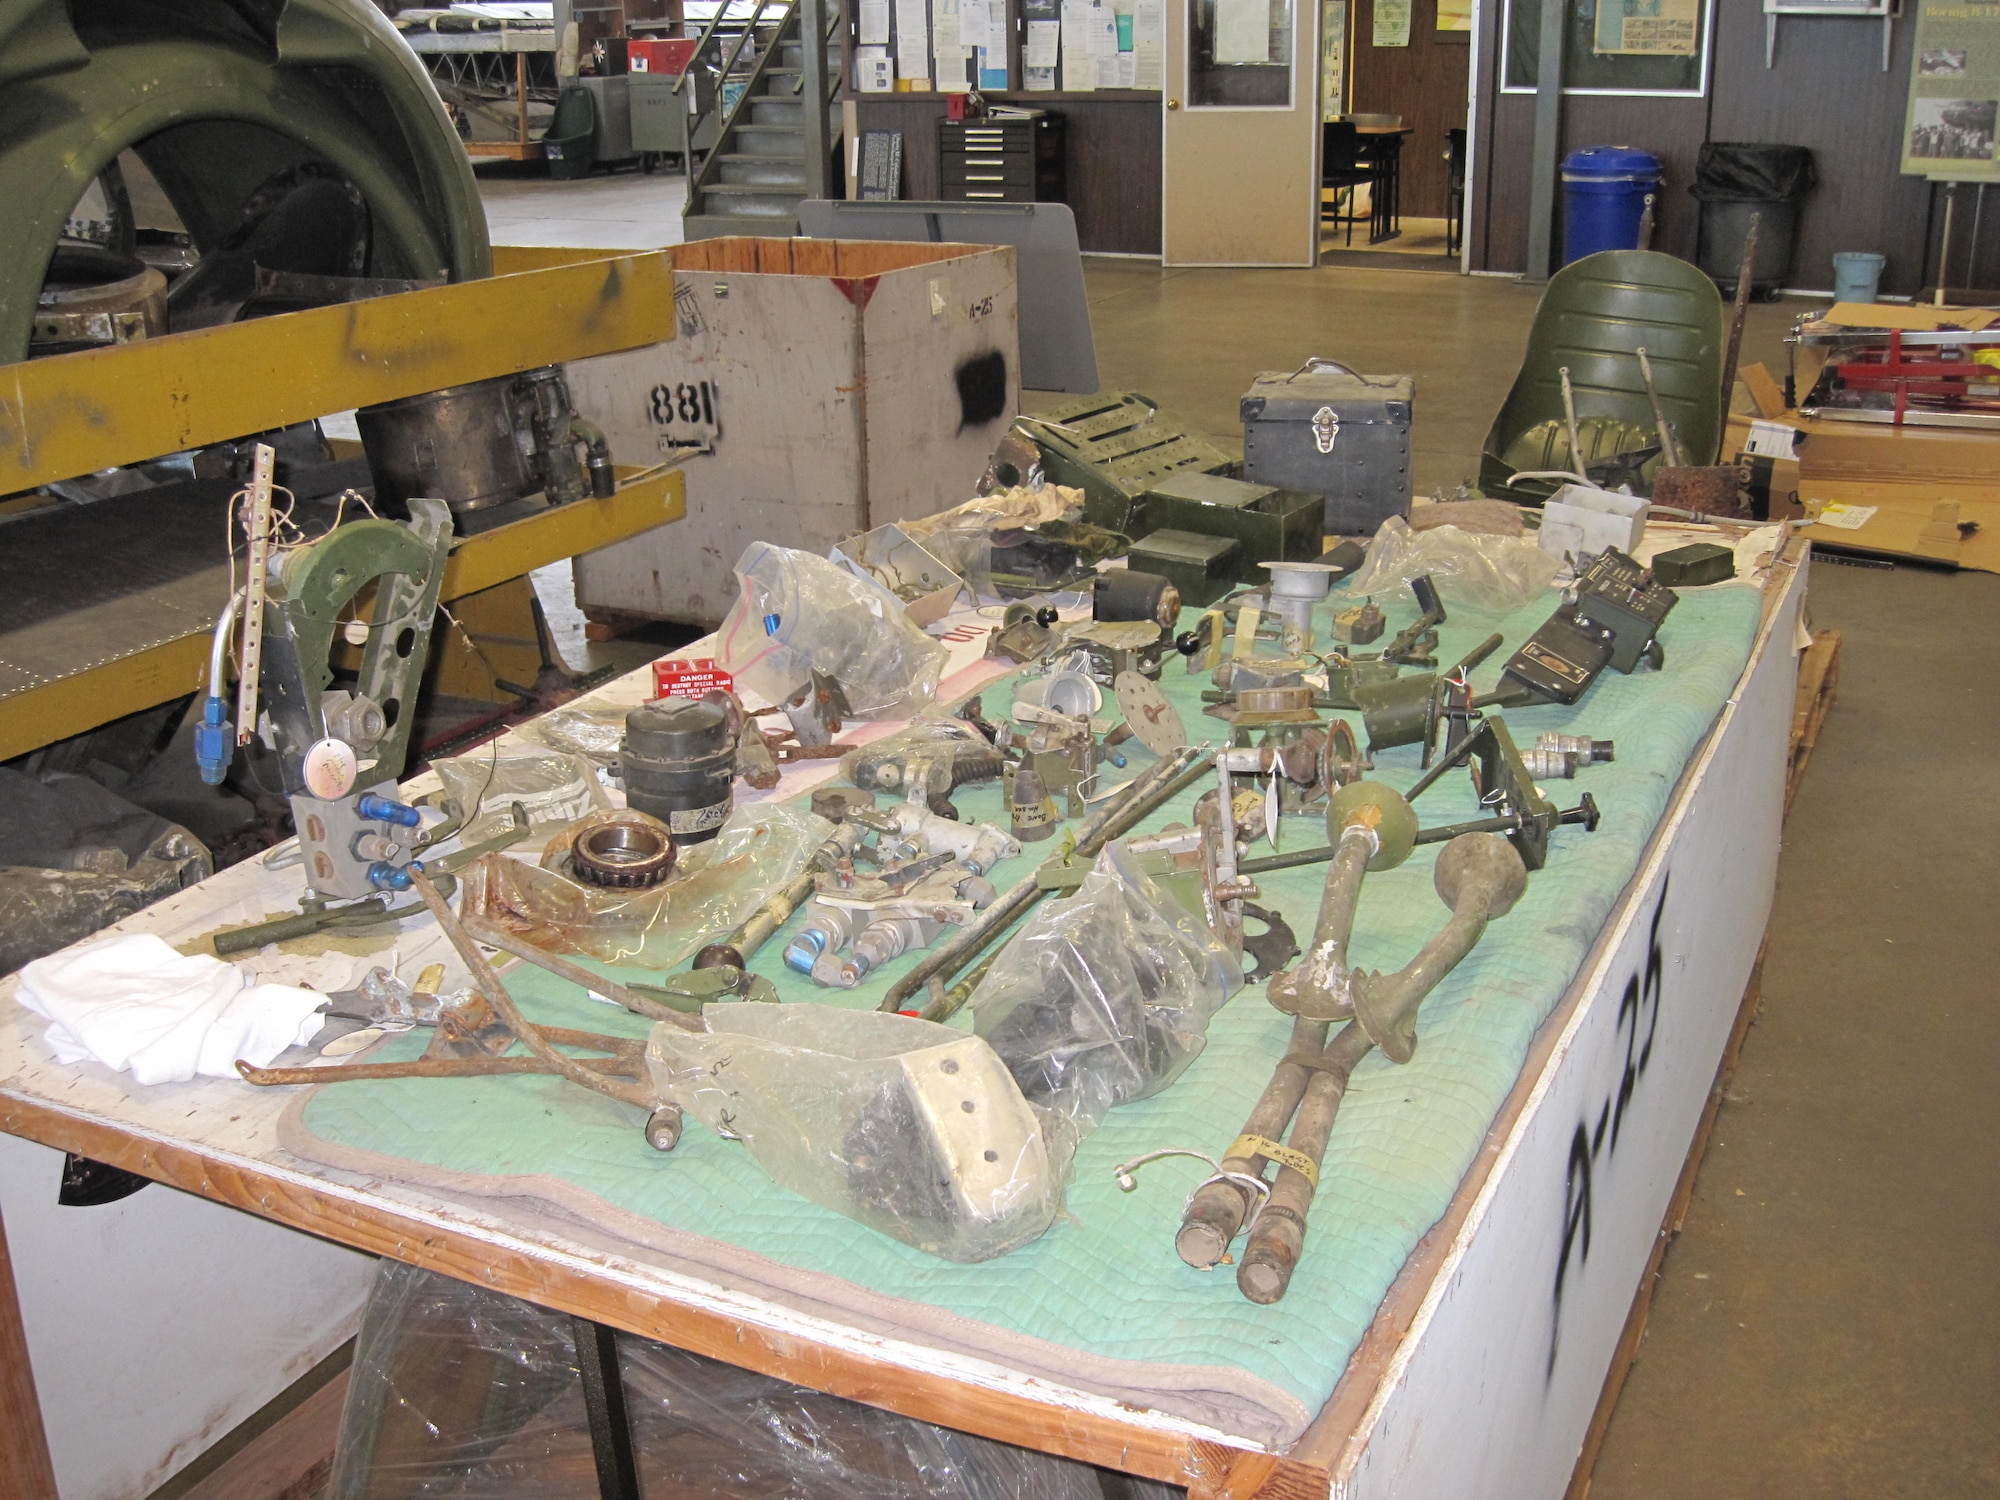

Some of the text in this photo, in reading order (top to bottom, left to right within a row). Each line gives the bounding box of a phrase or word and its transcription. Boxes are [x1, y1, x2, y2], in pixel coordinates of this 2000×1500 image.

[1925, 6, 1967, 18] Boeing
[651, 381, 713, 425] 881
[680, 673, 714, 682] DANGER
